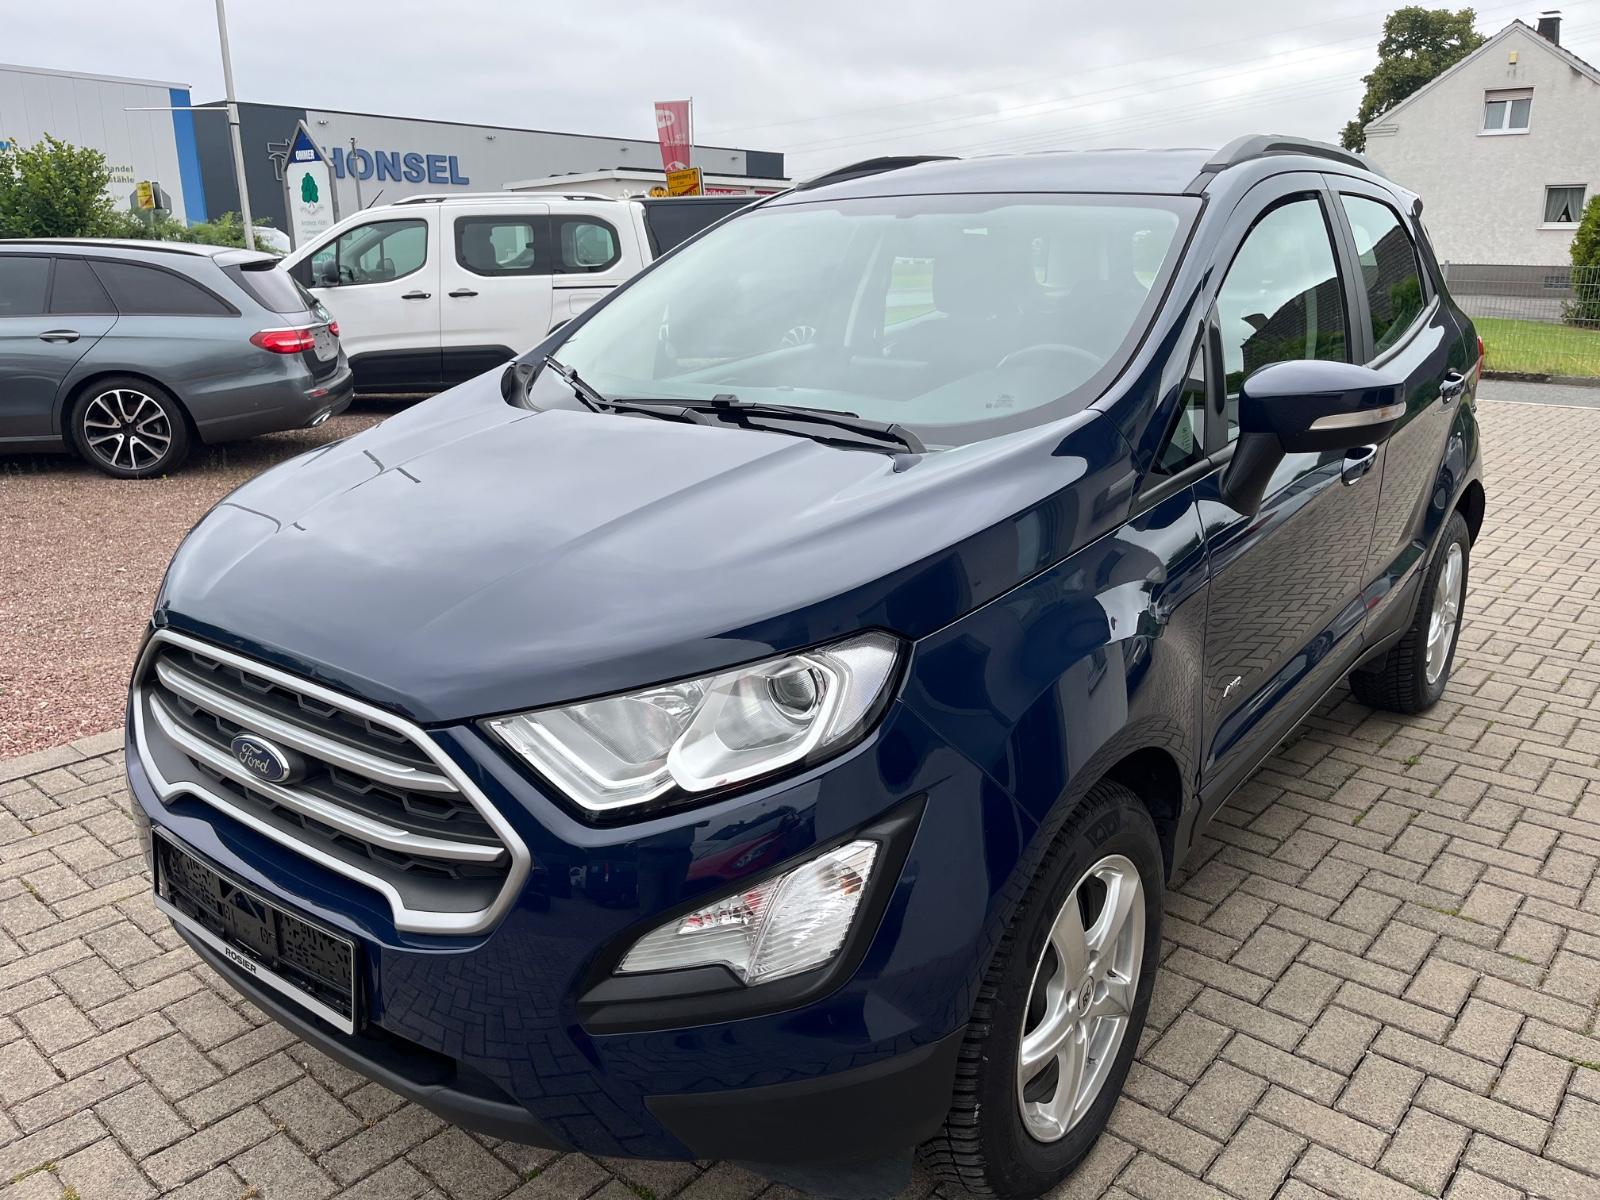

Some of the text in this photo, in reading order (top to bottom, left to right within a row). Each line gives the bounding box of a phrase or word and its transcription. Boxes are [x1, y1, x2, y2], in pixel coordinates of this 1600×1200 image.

[322, 146, 470, 186] HONSEL
[239, 743, 270, 774] Ford
[225, 947, 257, 974] ROSIER
